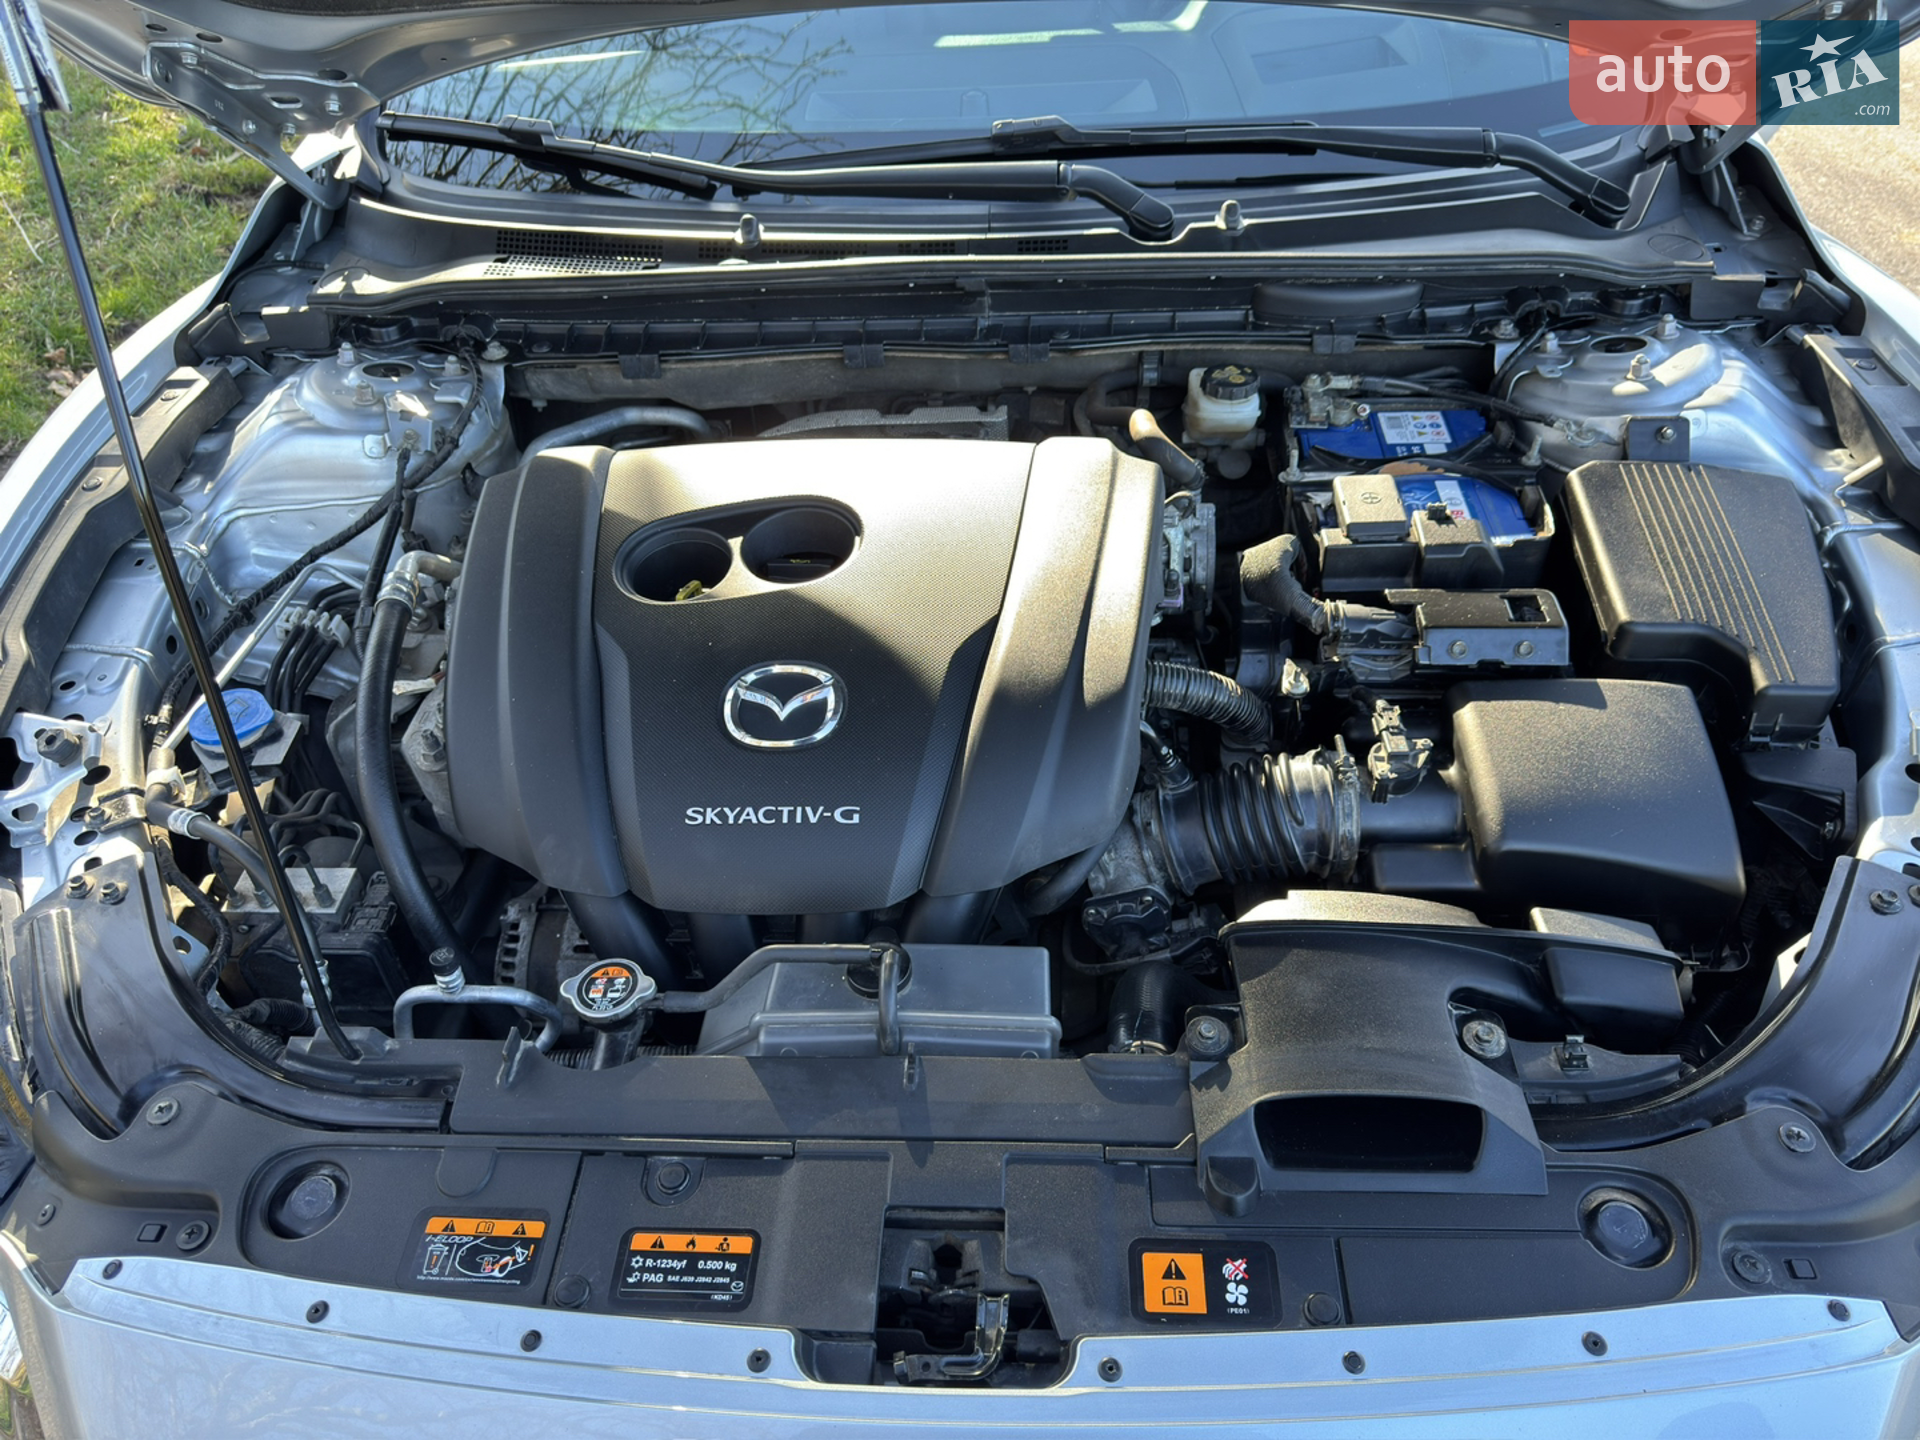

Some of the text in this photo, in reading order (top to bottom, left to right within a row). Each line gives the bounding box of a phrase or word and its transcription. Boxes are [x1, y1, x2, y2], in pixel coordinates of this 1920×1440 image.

[684, 805, 861, 825] SKYACTIV-G
[645, 1258, 737, 1272] R-1234yf 0.500 kg
[642, 1273, 664, 1283] PAG
